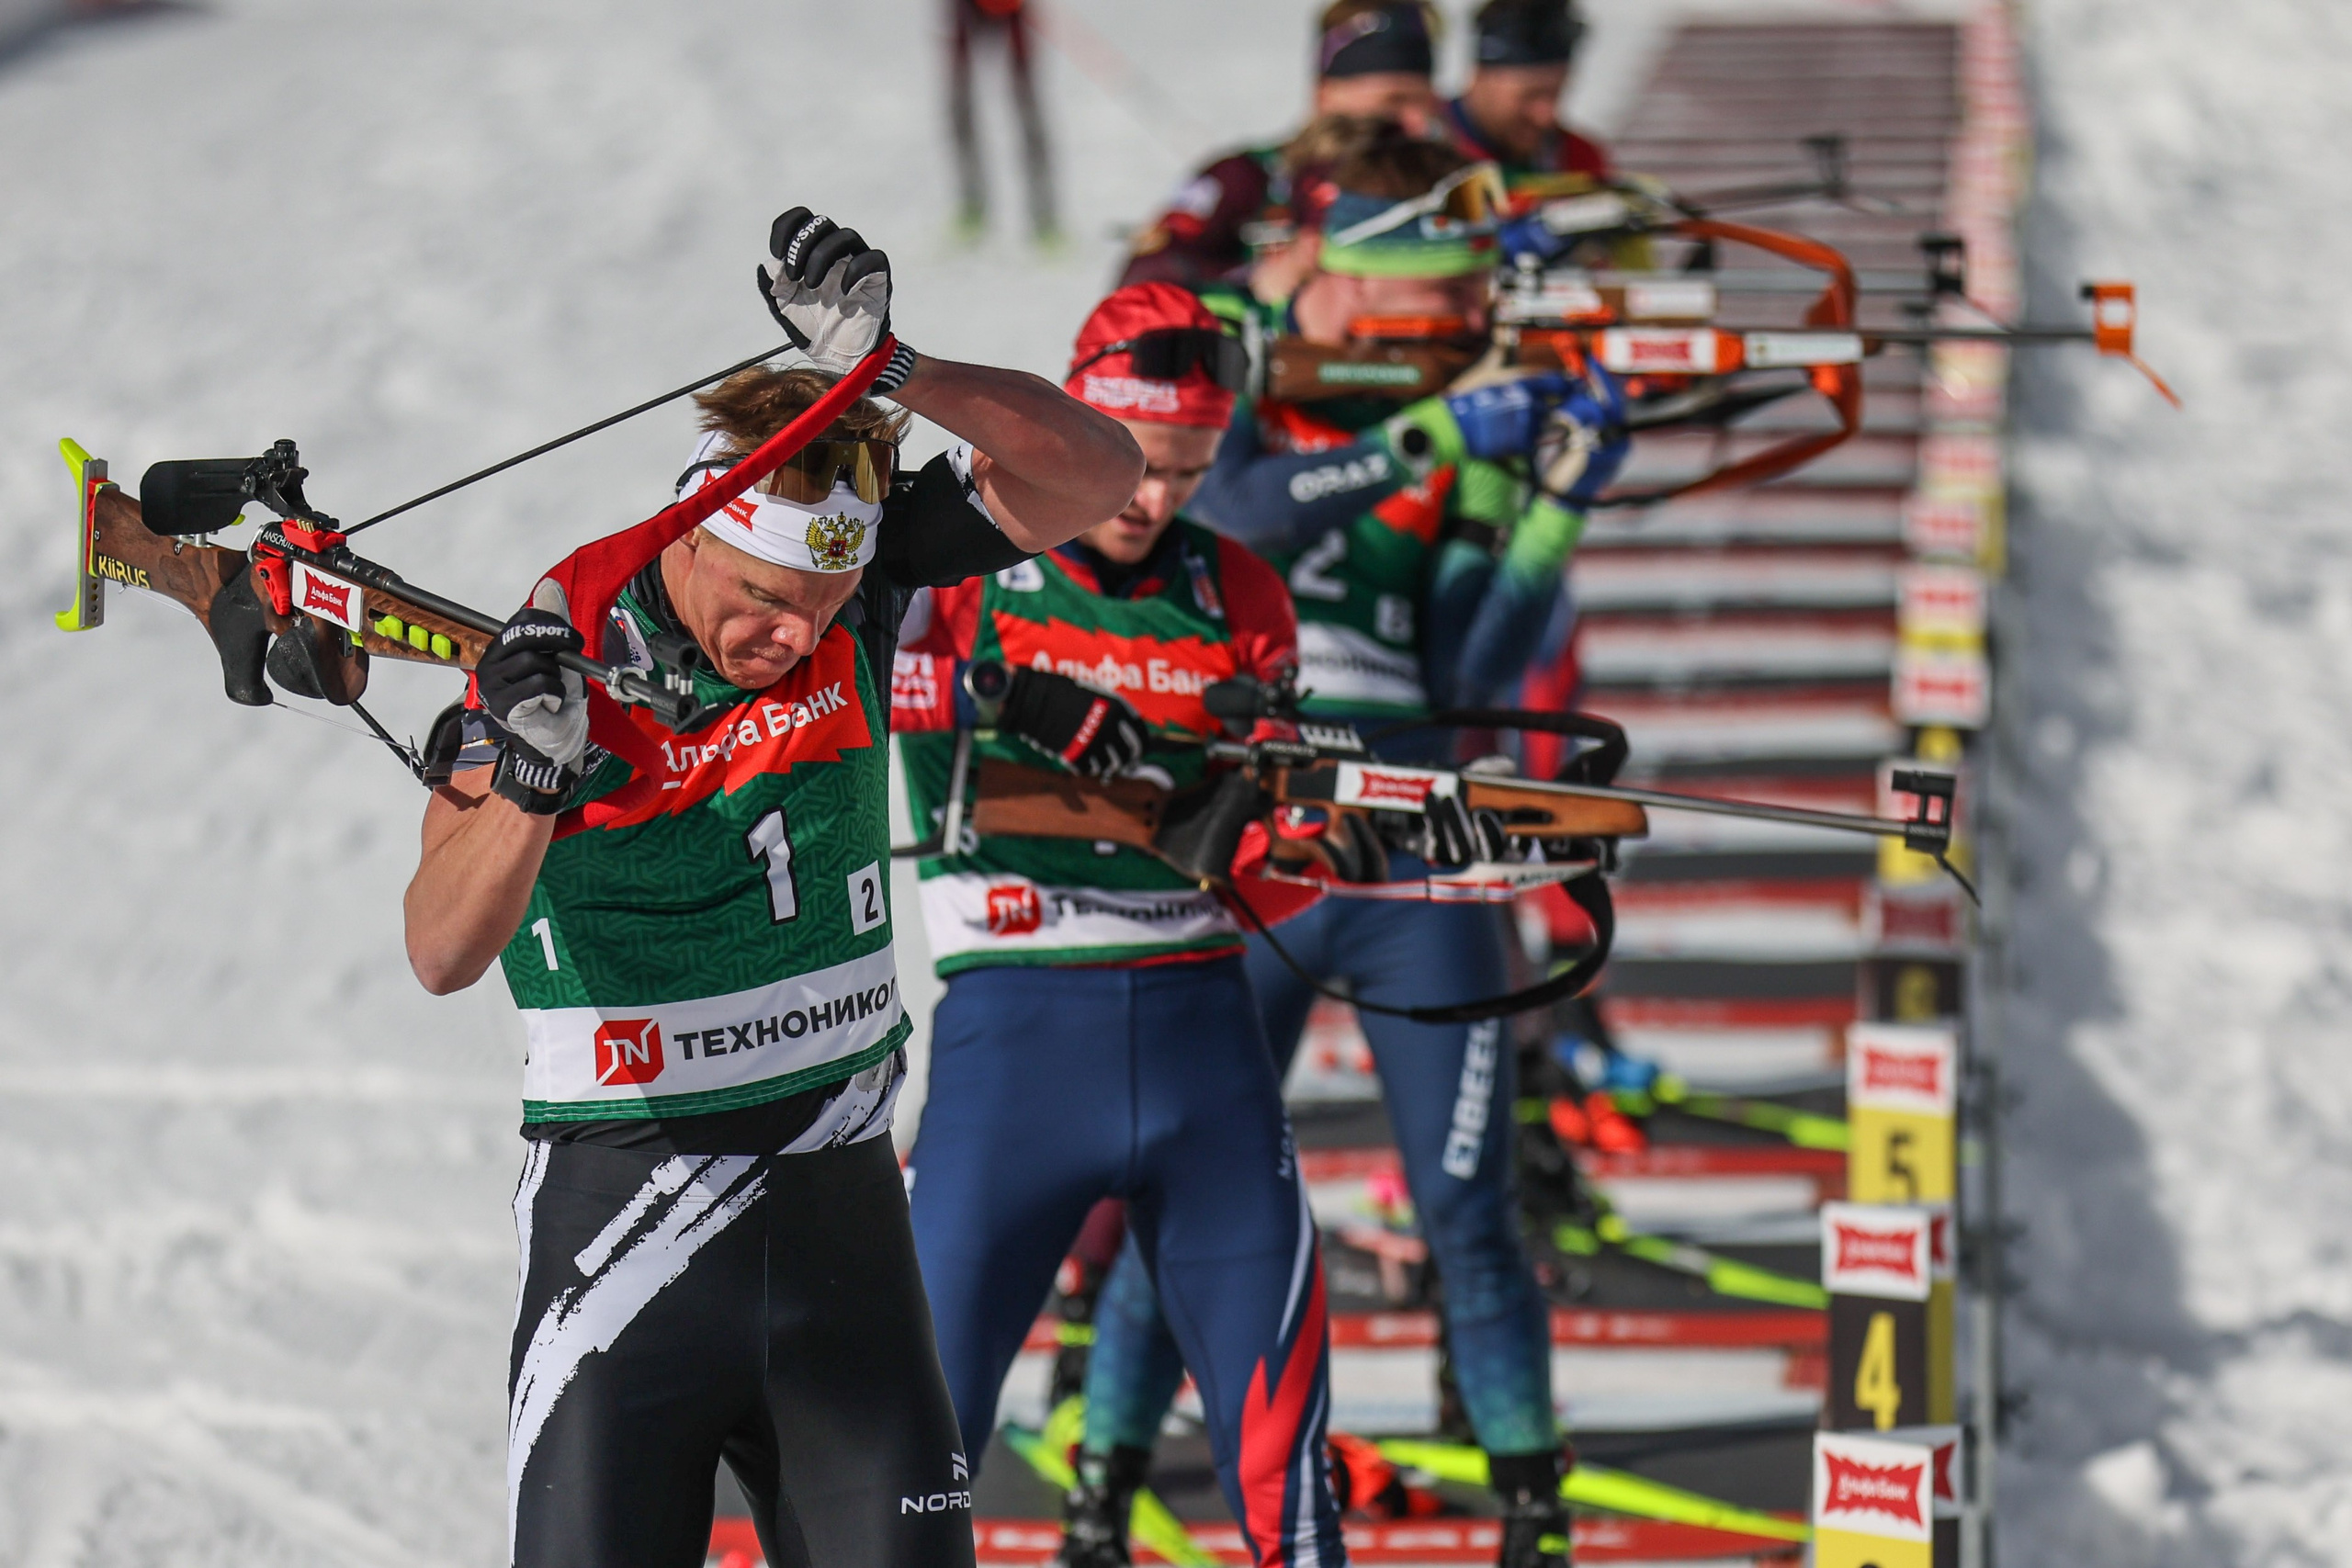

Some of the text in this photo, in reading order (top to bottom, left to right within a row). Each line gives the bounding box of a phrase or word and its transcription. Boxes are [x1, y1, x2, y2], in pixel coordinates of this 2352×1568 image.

[311, 585, 343, 607] Альфа Банк
[1148, 659, 1219, 696] Бан
[661, 682, 849, 776] Альфа Банк
[742, 804, 800, 926] 1
[862, 878, 879, 923] 2
[532, 917, 560, 971] 1
[1886, 1126, 1918, 1201] 5
[1853, 1310, 1902, 1434] 4
[901, 1491, 971, 1515] NORD
